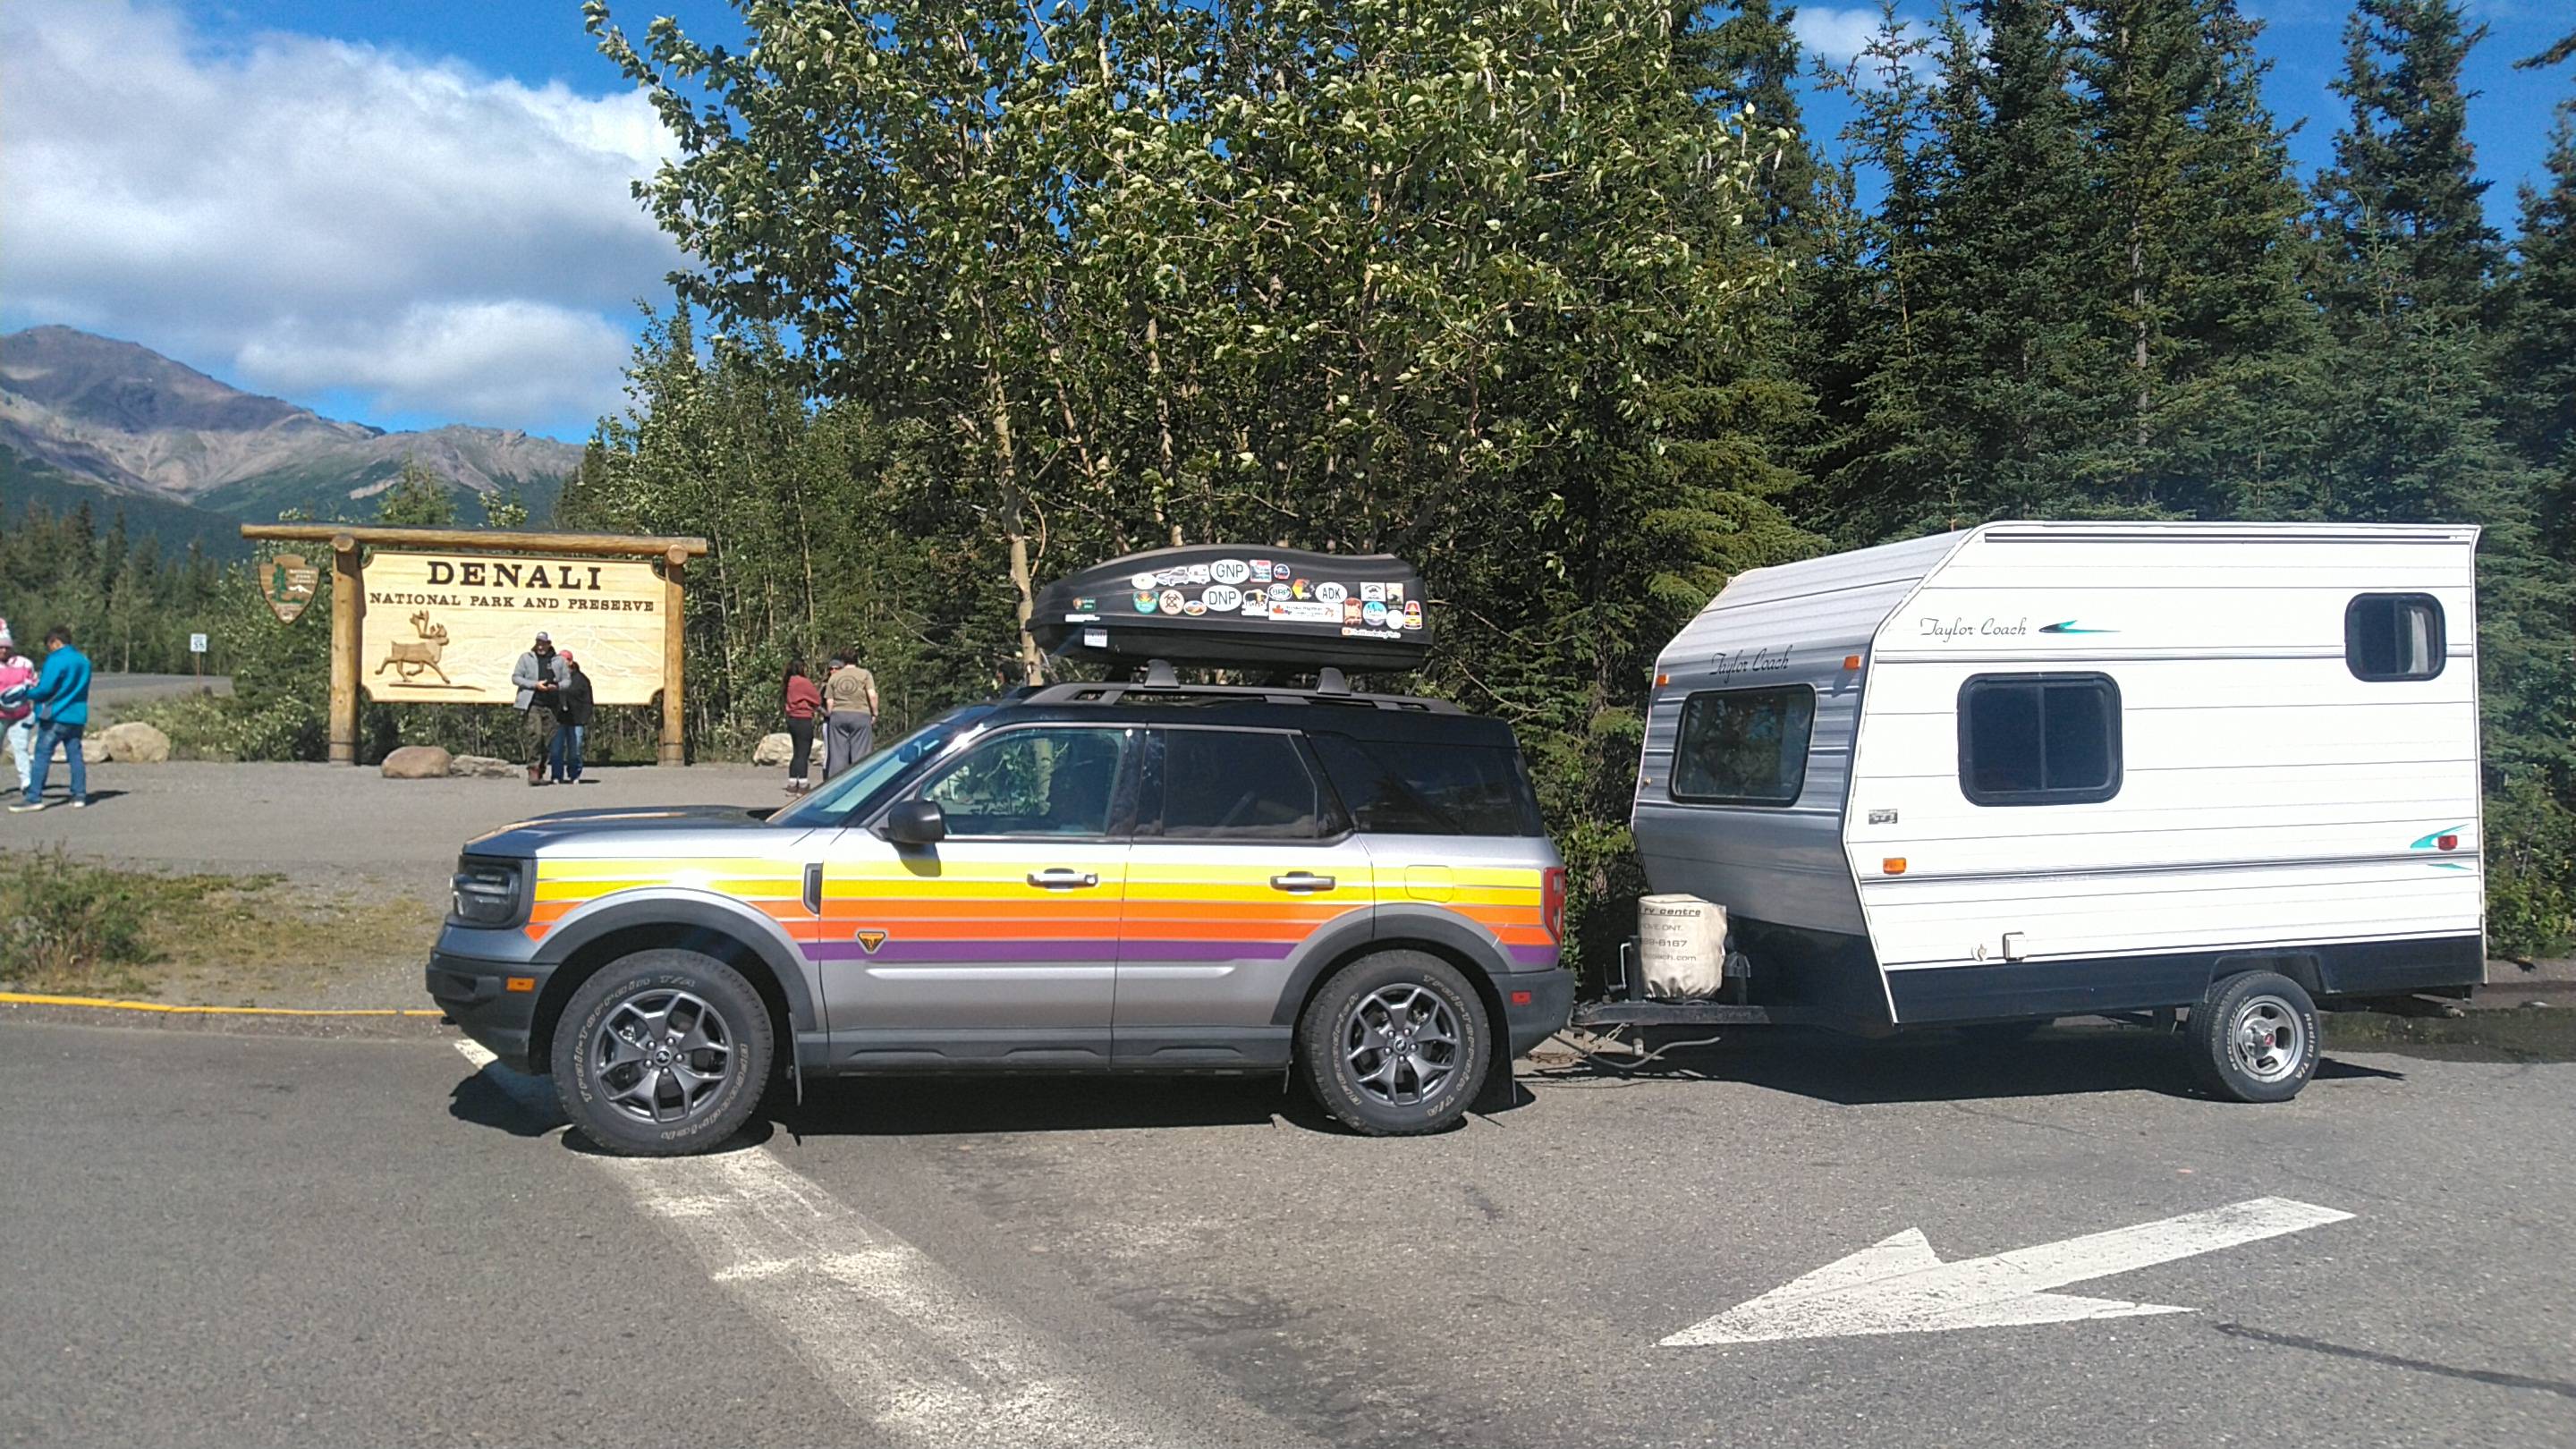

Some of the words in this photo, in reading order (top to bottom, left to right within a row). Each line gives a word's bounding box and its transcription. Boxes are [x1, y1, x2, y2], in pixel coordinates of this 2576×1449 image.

[427, 561, 601, 590] DENALI
[1216, 564, 1244, 579] GNP
[369, 592, 462, 606] NATIONAL
[470, 595, 515, 607] PARK
[523, 597, 559, 609] AND
[568, 597, 654, 612] PRESERVE
[1208, 590, 1237, 606] DNP
[1322, 587, 1342, 600] ADK
[1919, 616, 1974, 643] Taylor
[1980, 616, 2027, 636] Coach
[1708, 648, 1749, 684] Taylor
[1752, 644, 1793, 672] Coach
[1659, 908, 1701, 916] centre
[2304, 1013, 2317, 1058] Radial
[2295, 1062, 2310, 1080] T/A
